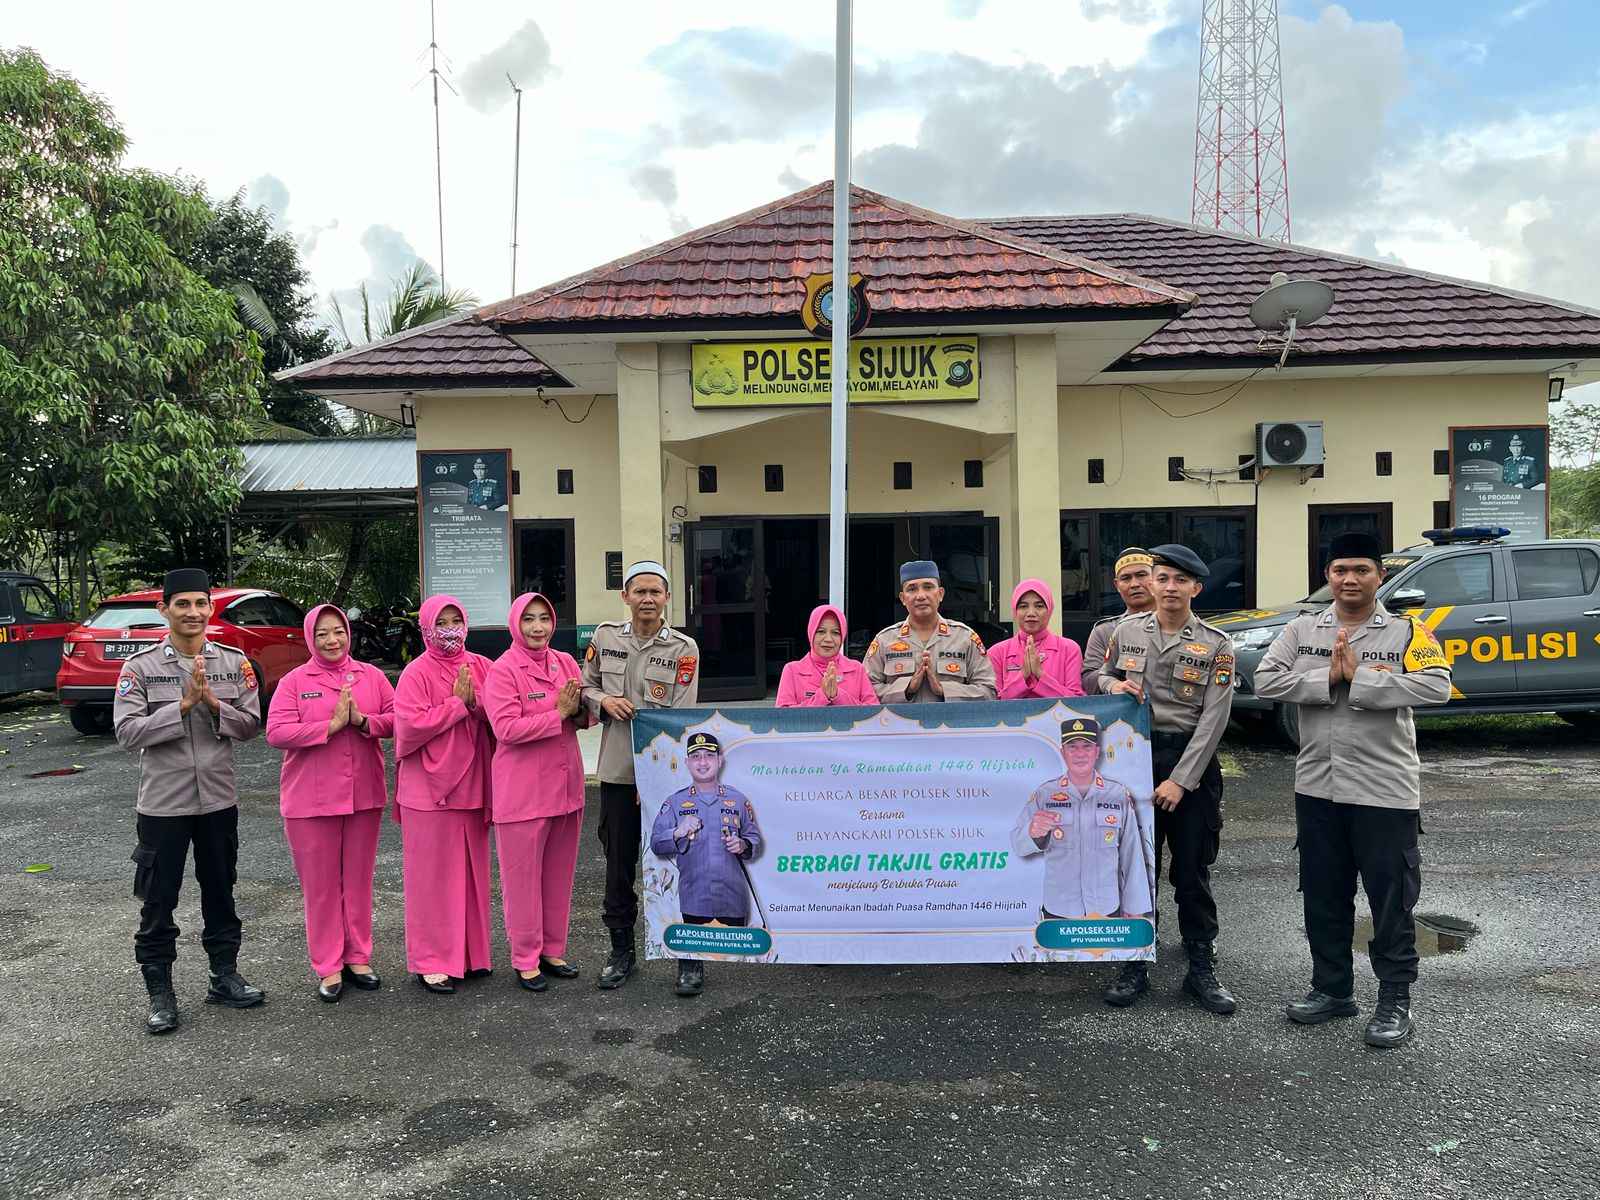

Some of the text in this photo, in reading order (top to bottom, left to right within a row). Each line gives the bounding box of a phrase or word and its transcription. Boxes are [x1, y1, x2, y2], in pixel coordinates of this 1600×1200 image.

[744, 345, 938, 382] POLSE SIJUK
[1121, 644, 1146, 655] DANDY
[1445, 632, 1577, 665] POLISI
[938, 651, 966, 660] POLRI
[1361, 651, 1400, 662] POLRI
[649, 657, 677, 670] POLRI
[1179, 655, 1210, 670] POLRI
[751, 758, 1036, 776] Marhaban Ya Ramadhan 1446 Hijriah
[784, 787, 992, 802] KELUARGA BESAR POLSEK SIJUK
[1097, 803, 1121, 811] POLRI
[859, 808, 906, 821] Bersama
[796, 826, 986, 842] BHAYANGKARI POLSEK SIJUK
[776, 850, 1009, 874] BERBAGI TAKJIL GRATIS
[827, 877, 959, 892] menjelang Berbuka Puasa
[768, 903, 806, 913] Selamat
[807, 902, 862, 912] Menunaikan
[863, 902, 894, 912] Ibadah
[895, 902, 924, 912] Puasa
[925, 901, 968, 911] Ramdhan
[970, 900, 993, 910] 1446
[675, 928, 753, 941] KAPOLRES BELITUNG
[1059, 925, 1131, 936] KAPOLSEK SIJUK
